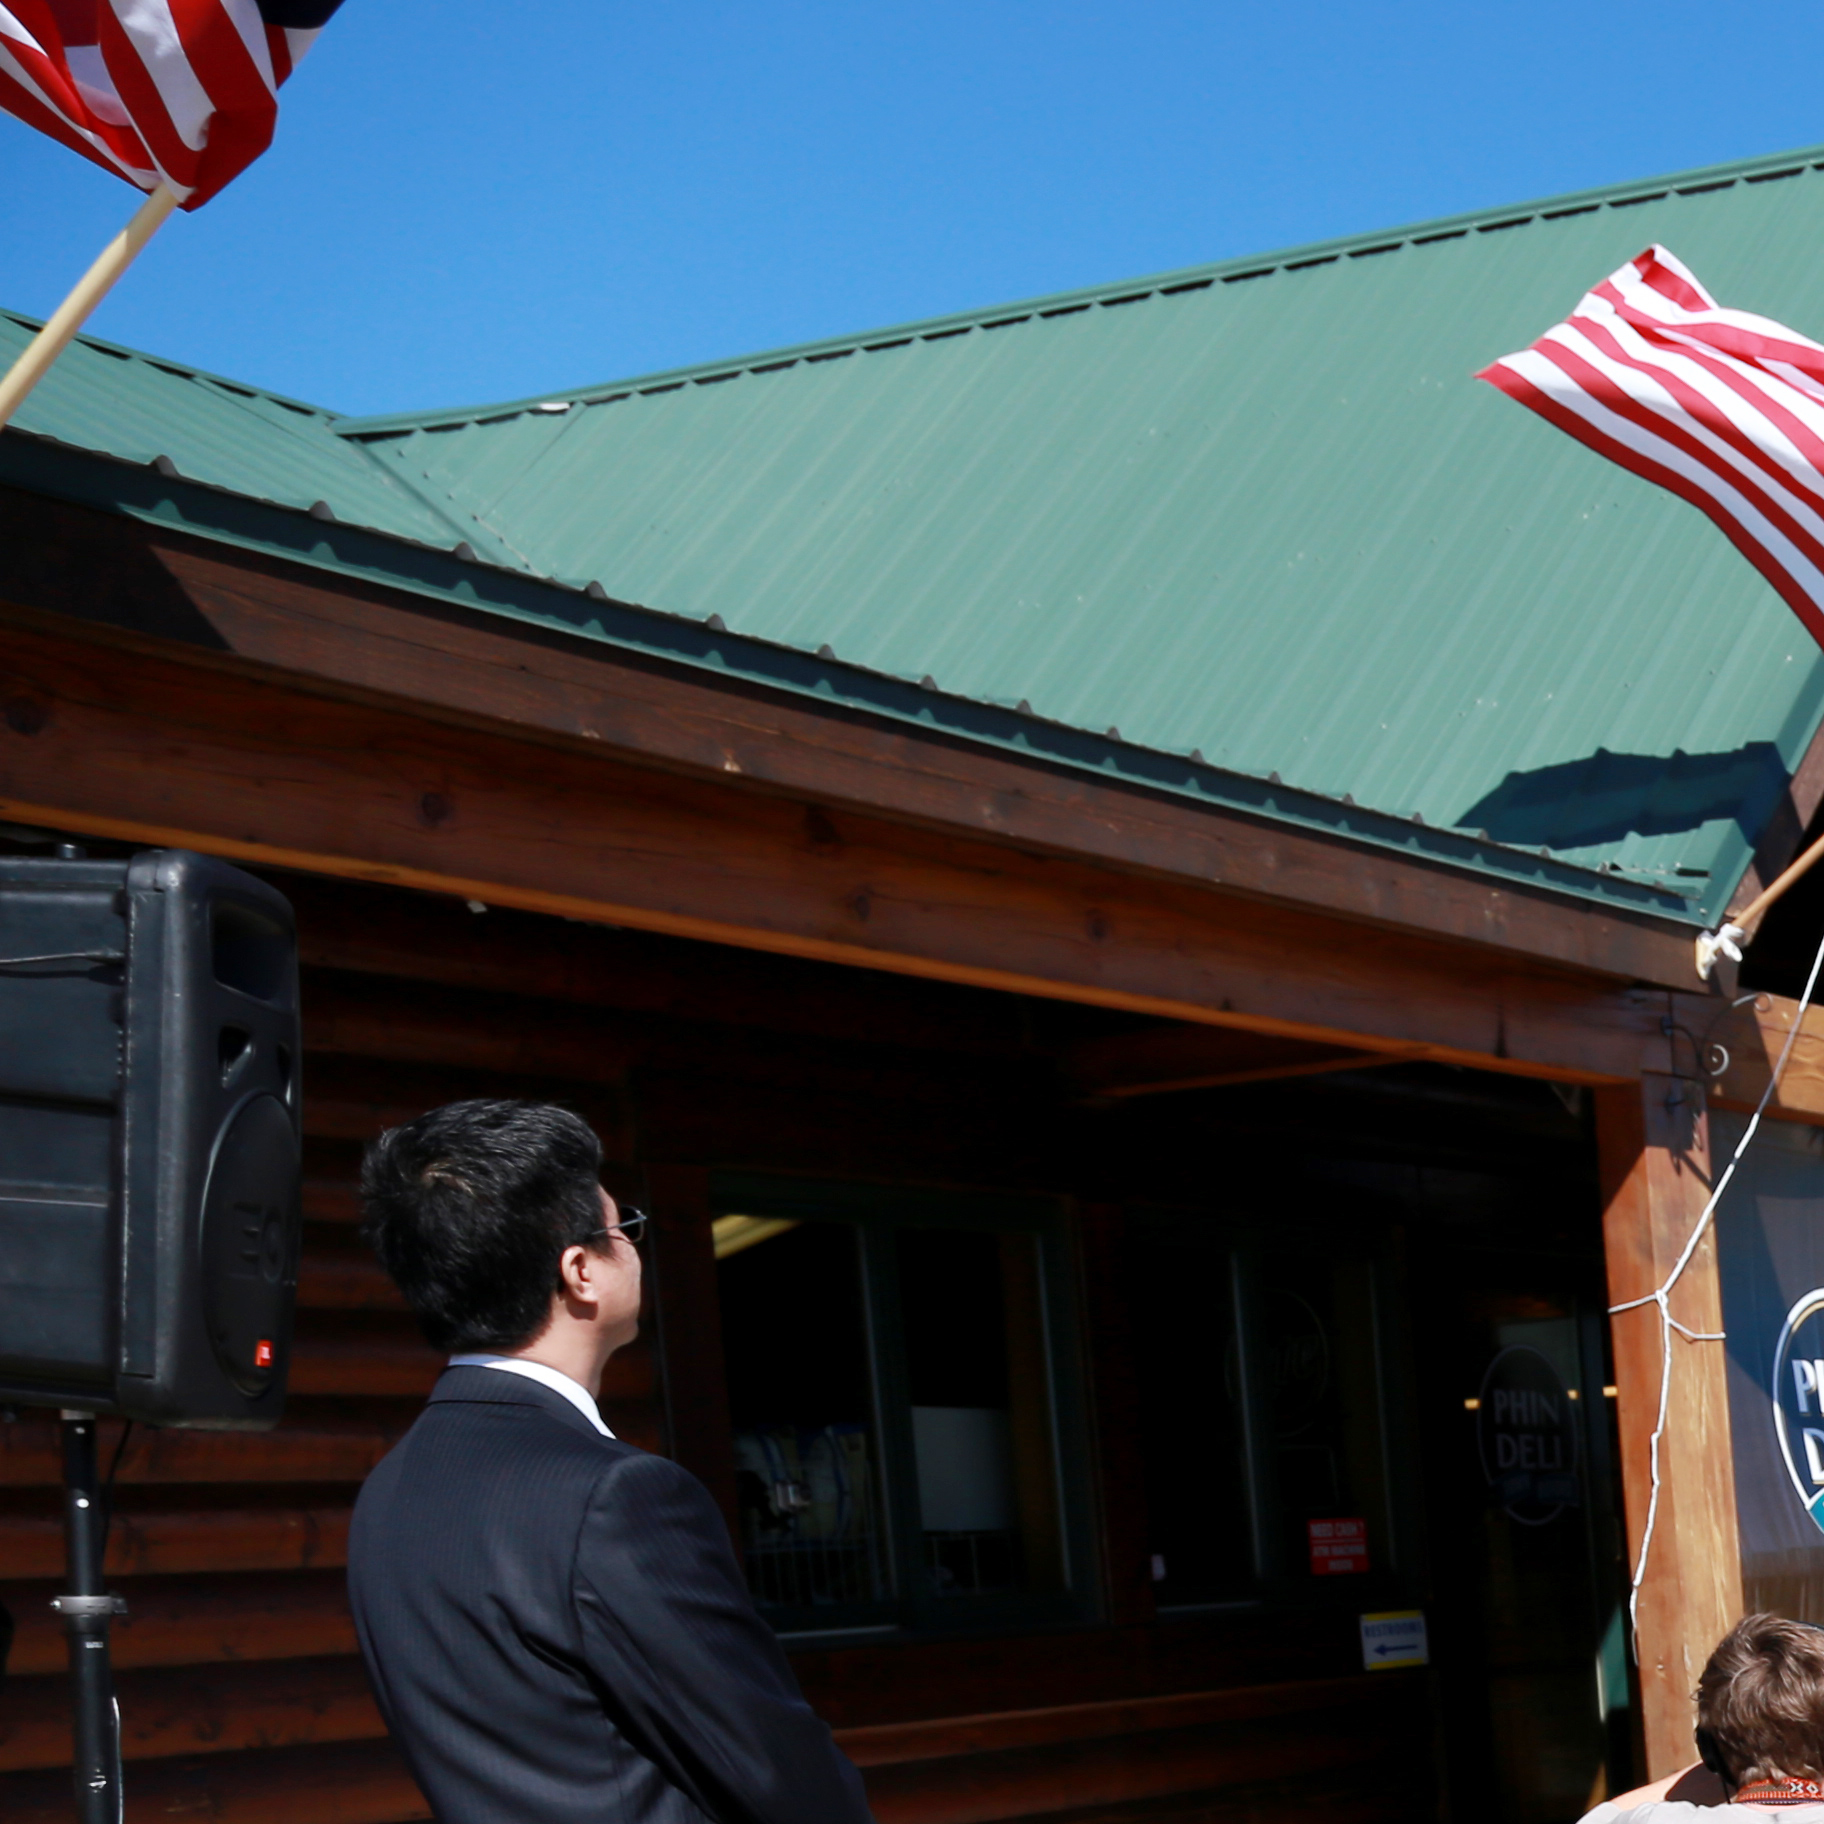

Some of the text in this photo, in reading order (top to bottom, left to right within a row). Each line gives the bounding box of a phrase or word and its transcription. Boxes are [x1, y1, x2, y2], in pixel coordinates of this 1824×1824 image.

[1492, 1389, 1561, 1425] PHIN
[1494, 1432, 1563, 1470] DELI
[1363, 1621, 1425, 1638] RESTROOMS
